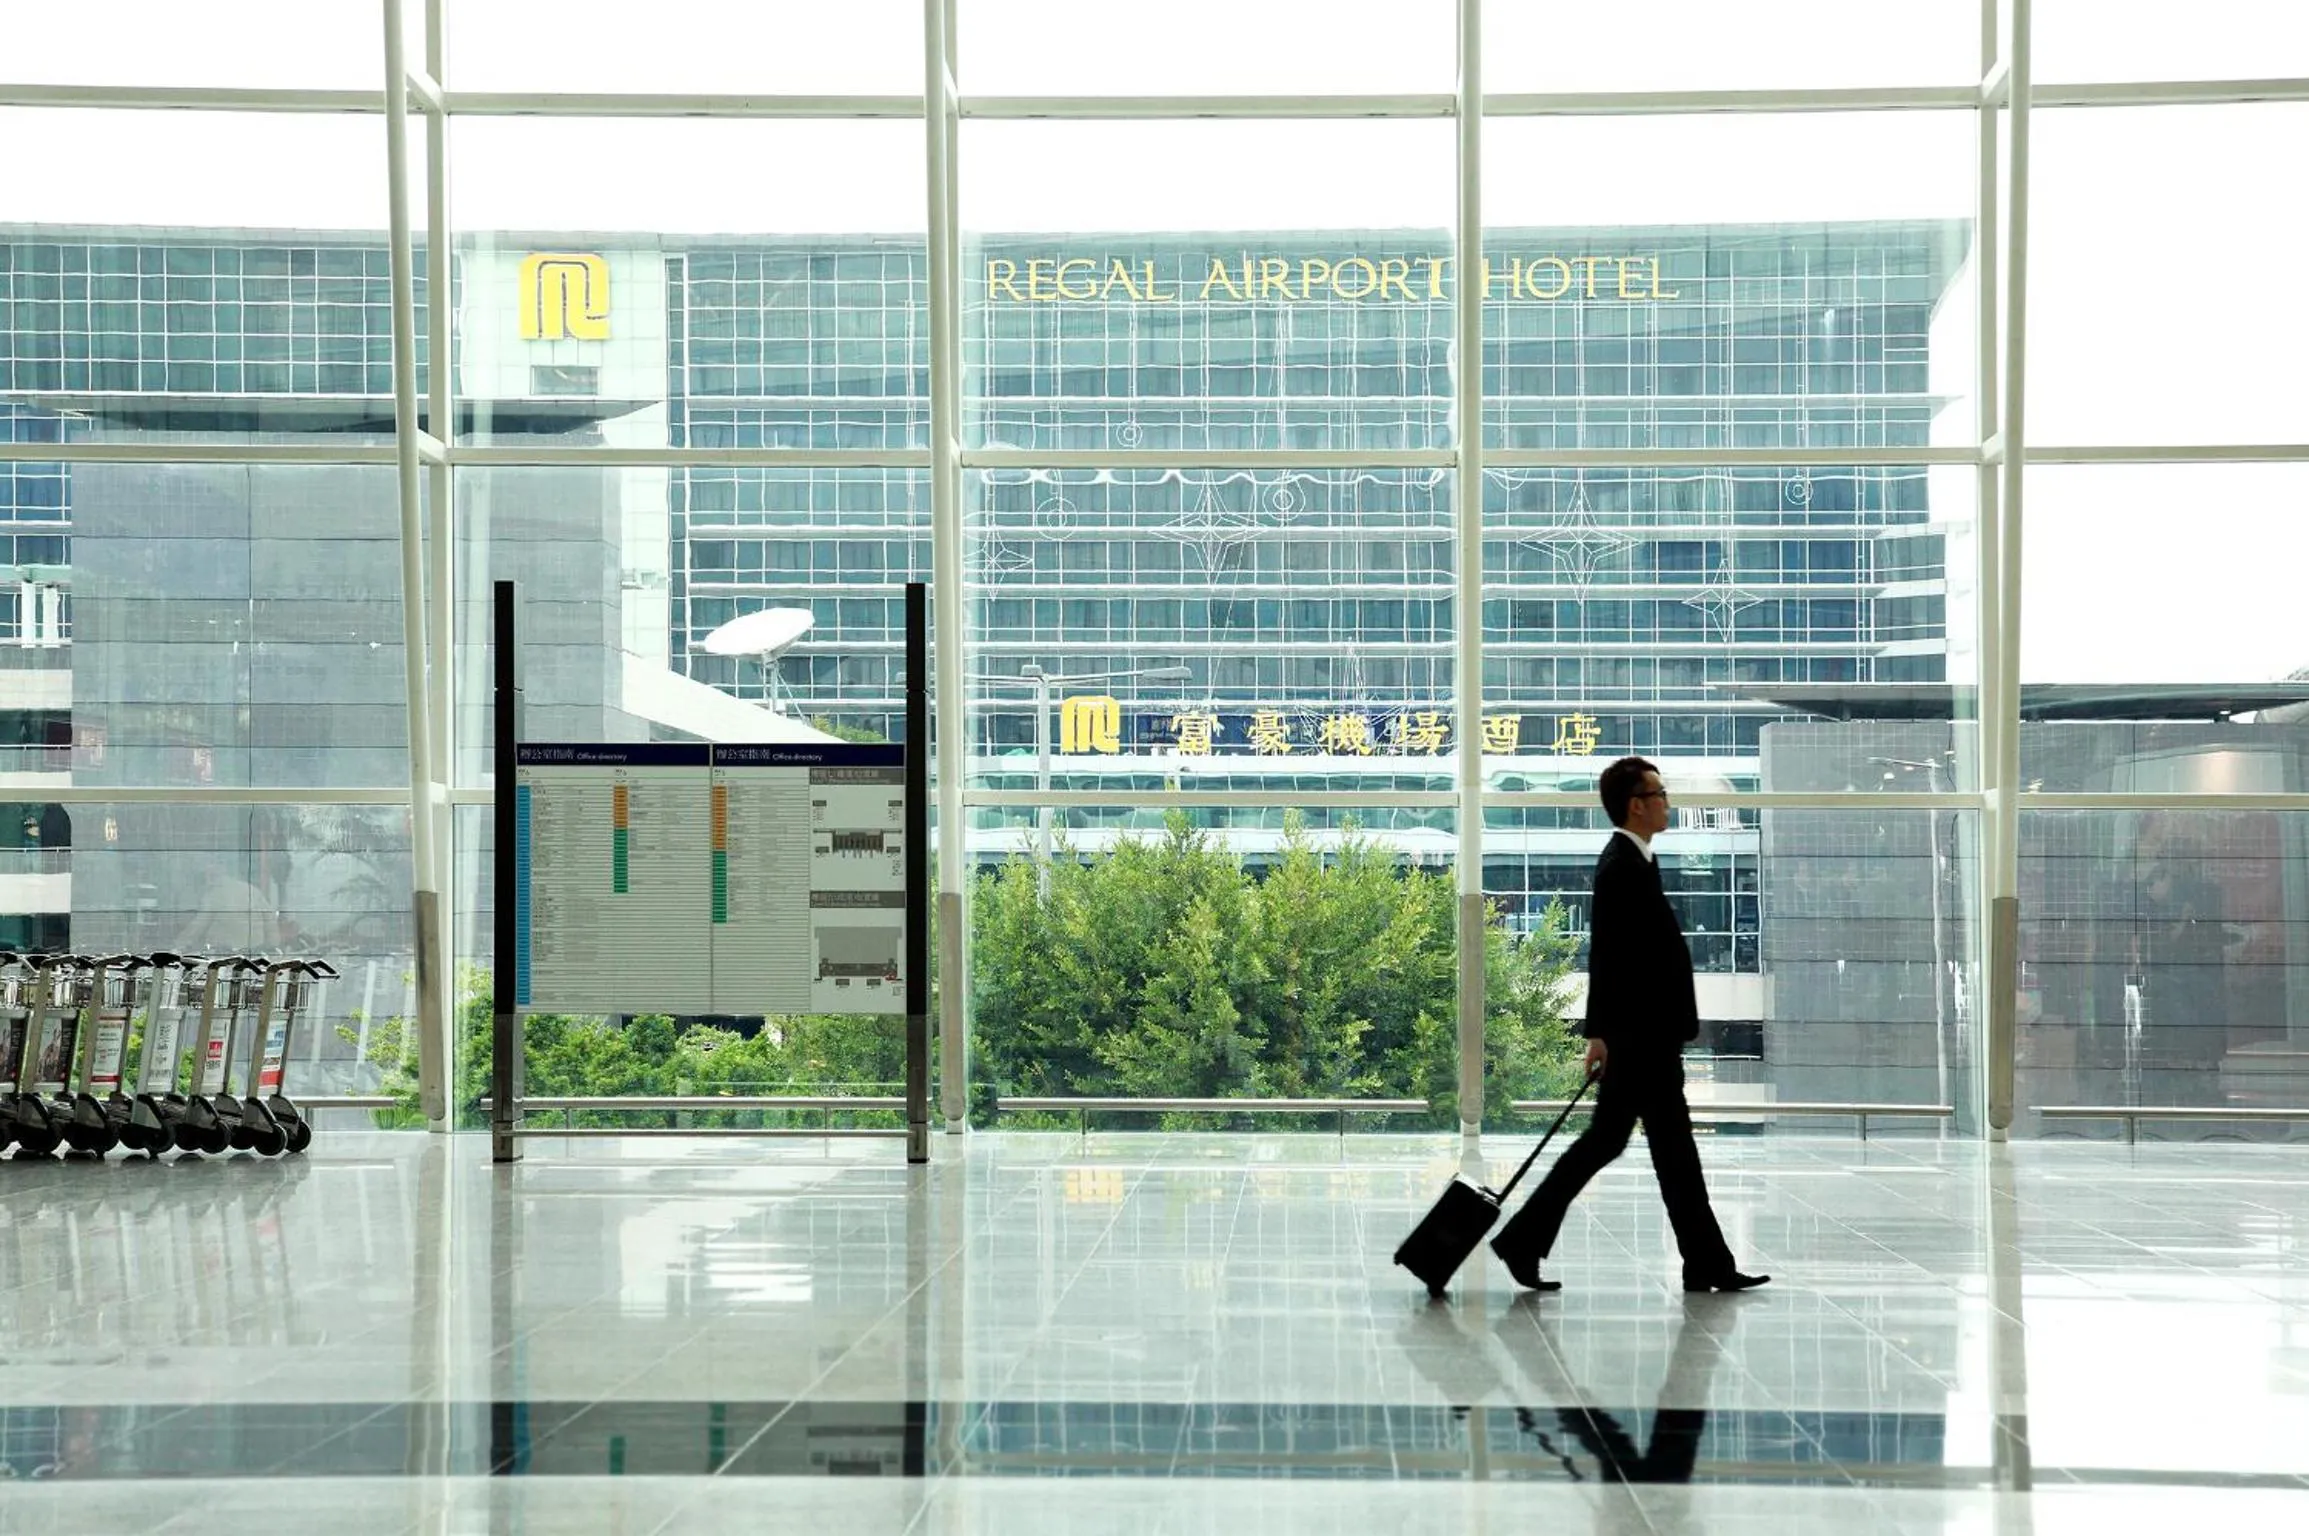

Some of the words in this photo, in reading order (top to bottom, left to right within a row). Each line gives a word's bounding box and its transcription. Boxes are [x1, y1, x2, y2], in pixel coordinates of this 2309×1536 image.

[986, 258, 1176, 301] REGAL
[1199, 256, 1452, 301] AIRPORT
[1481, 255, 1680, 300] HOTEL
